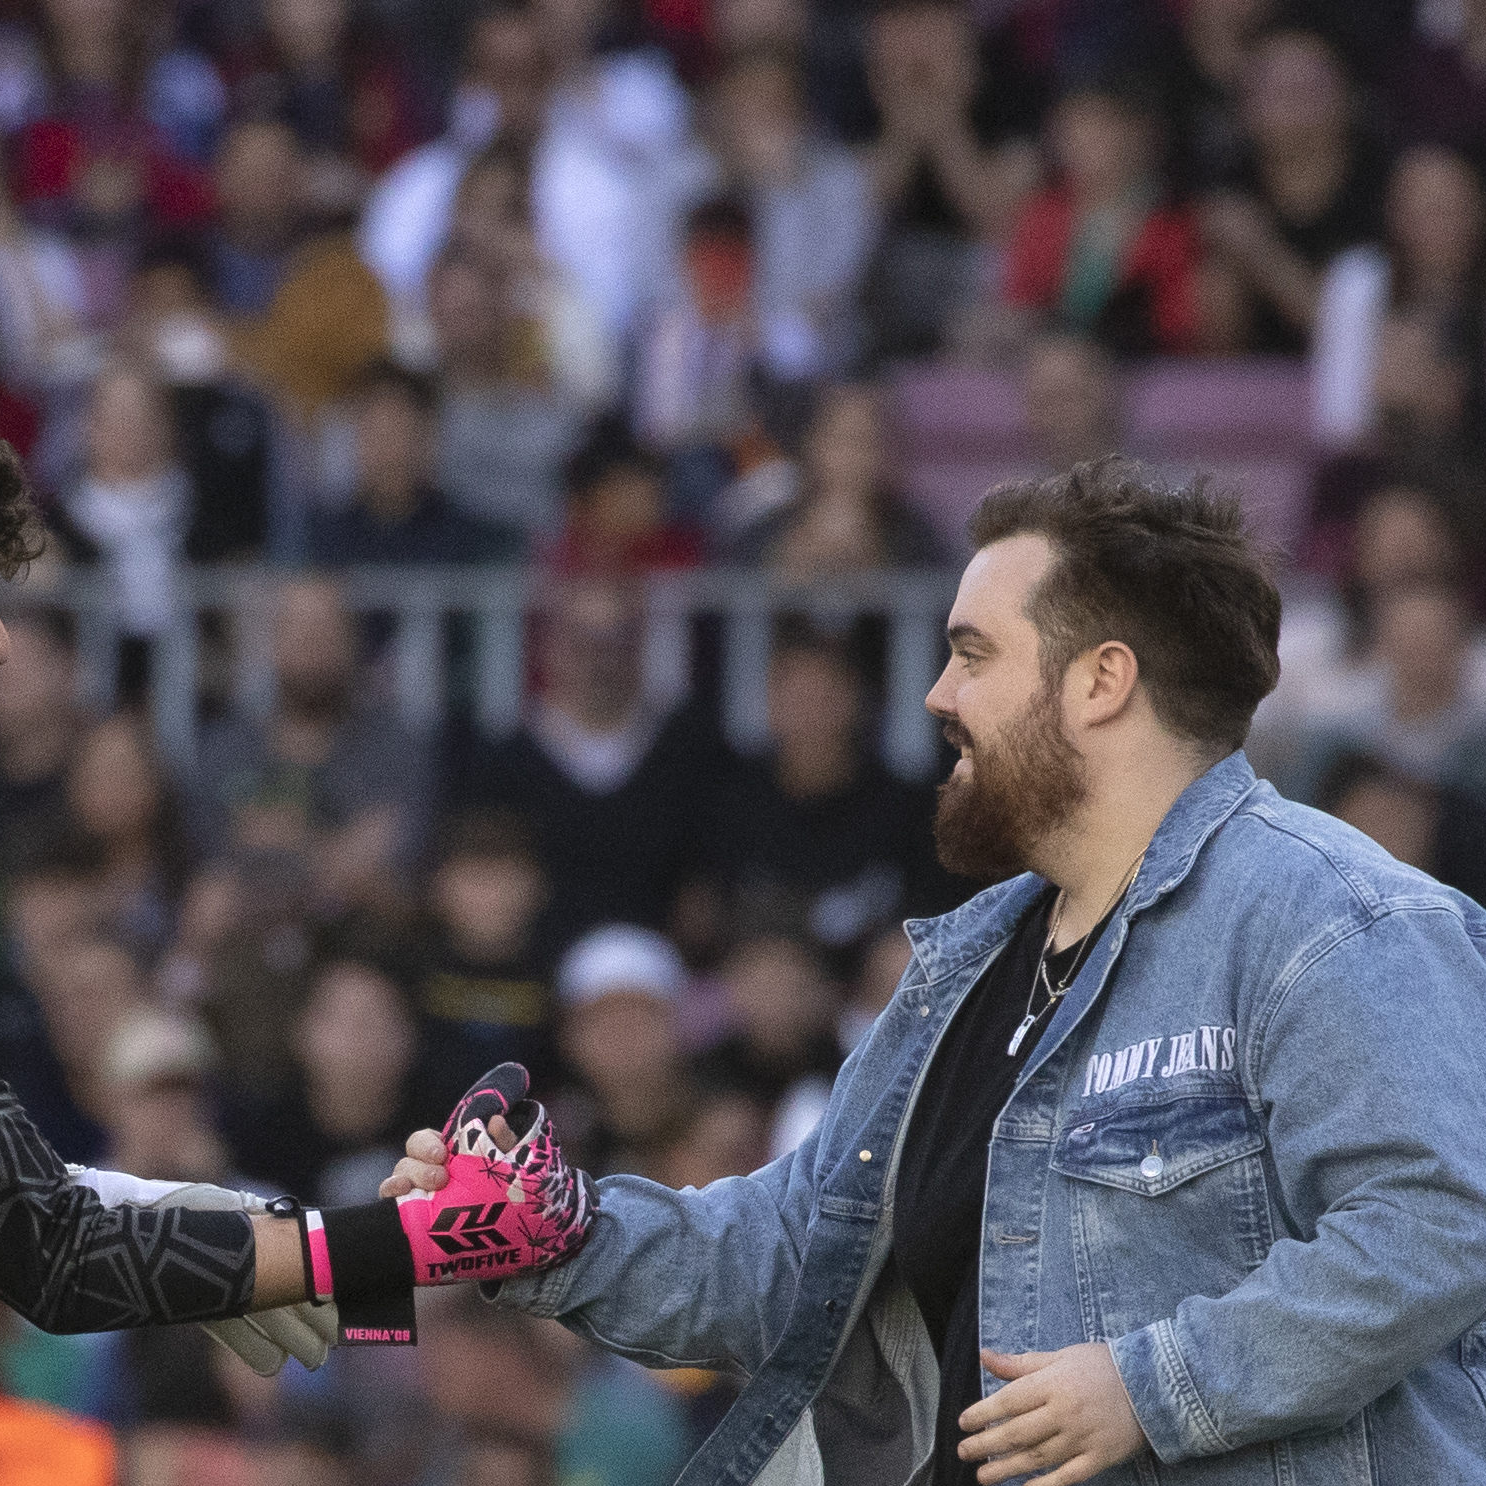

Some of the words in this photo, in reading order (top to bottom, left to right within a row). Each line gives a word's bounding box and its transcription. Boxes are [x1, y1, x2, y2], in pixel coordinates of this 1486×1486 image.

[1082, 1038, 1163, 1097] TOMMY
[1161, 1026, 1236, 1078] JEANS
[427, 1248, 521, 1279] TWOFIVE
[345, 1328, 411, 1342] VIENNA'08
